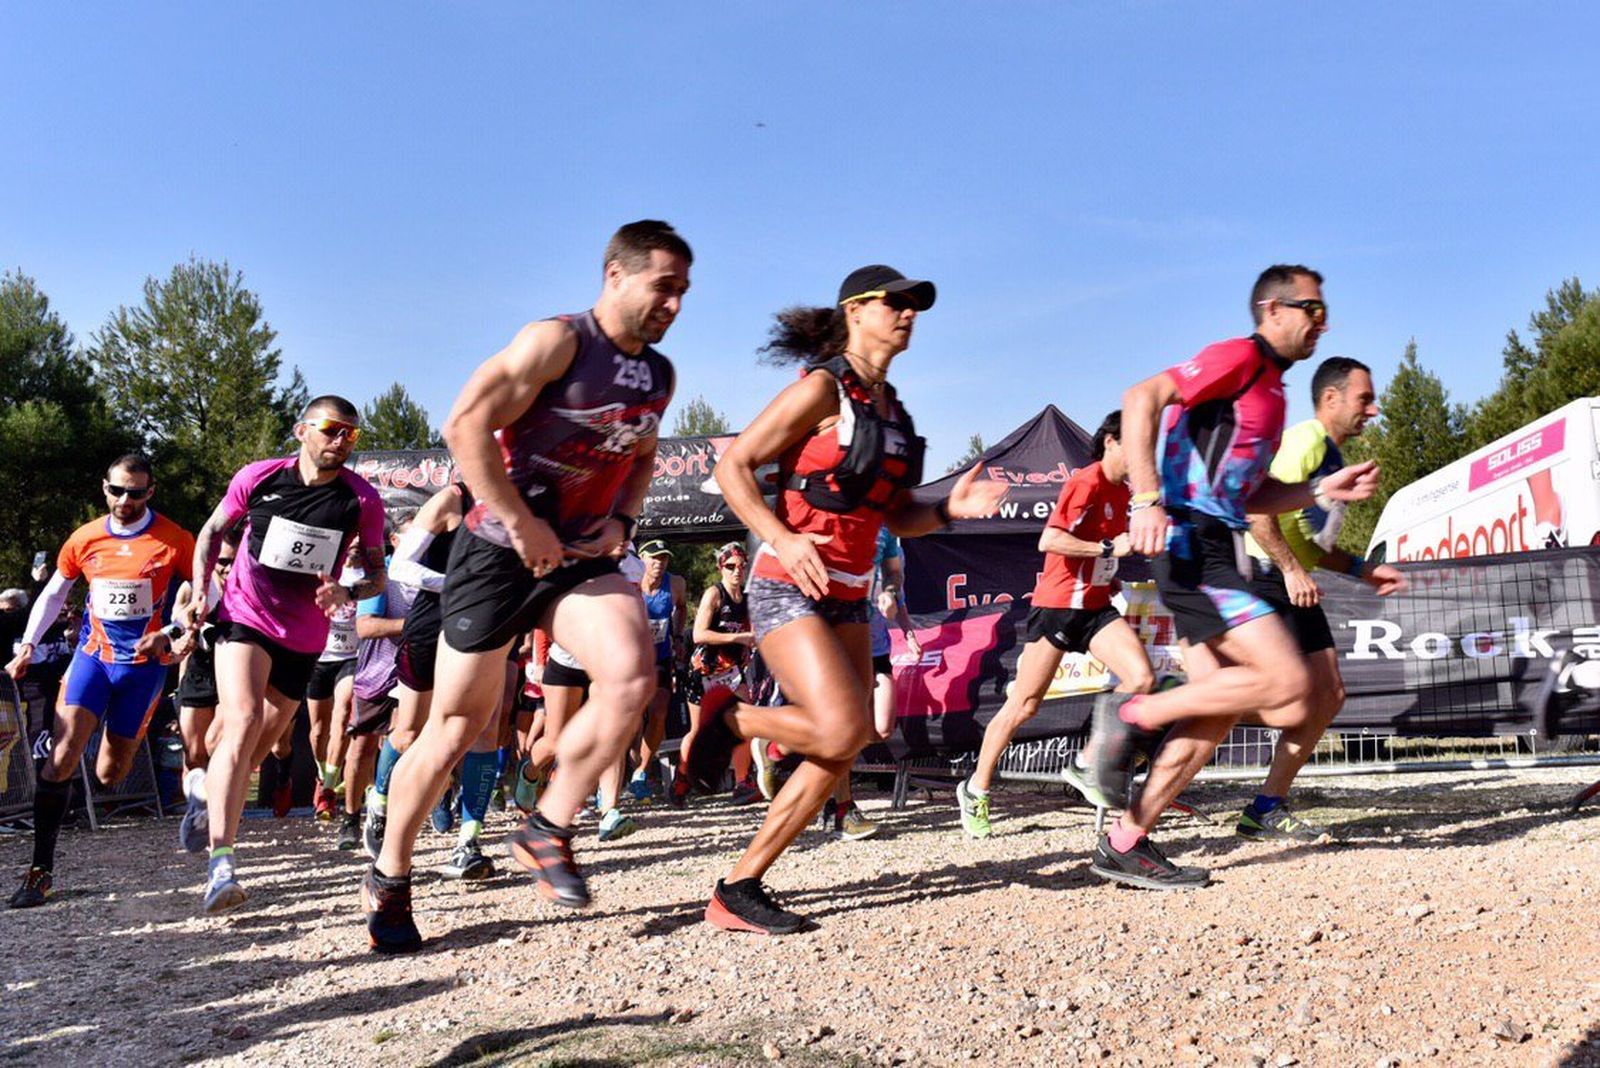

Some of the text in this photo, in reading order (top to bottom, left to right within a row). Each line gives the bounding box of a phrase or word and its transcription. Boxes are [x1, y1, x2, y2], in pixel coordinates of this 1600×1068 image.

[613, 354, 653, 391] 259
[1487, 431, 1543, 471] SOLISS
[660, 511, 724, 525] creciendo
[291, 541, 316, 556] 87
[109, 593, 137, 604] 228
[1346, 617, 1560, 660] Rock
